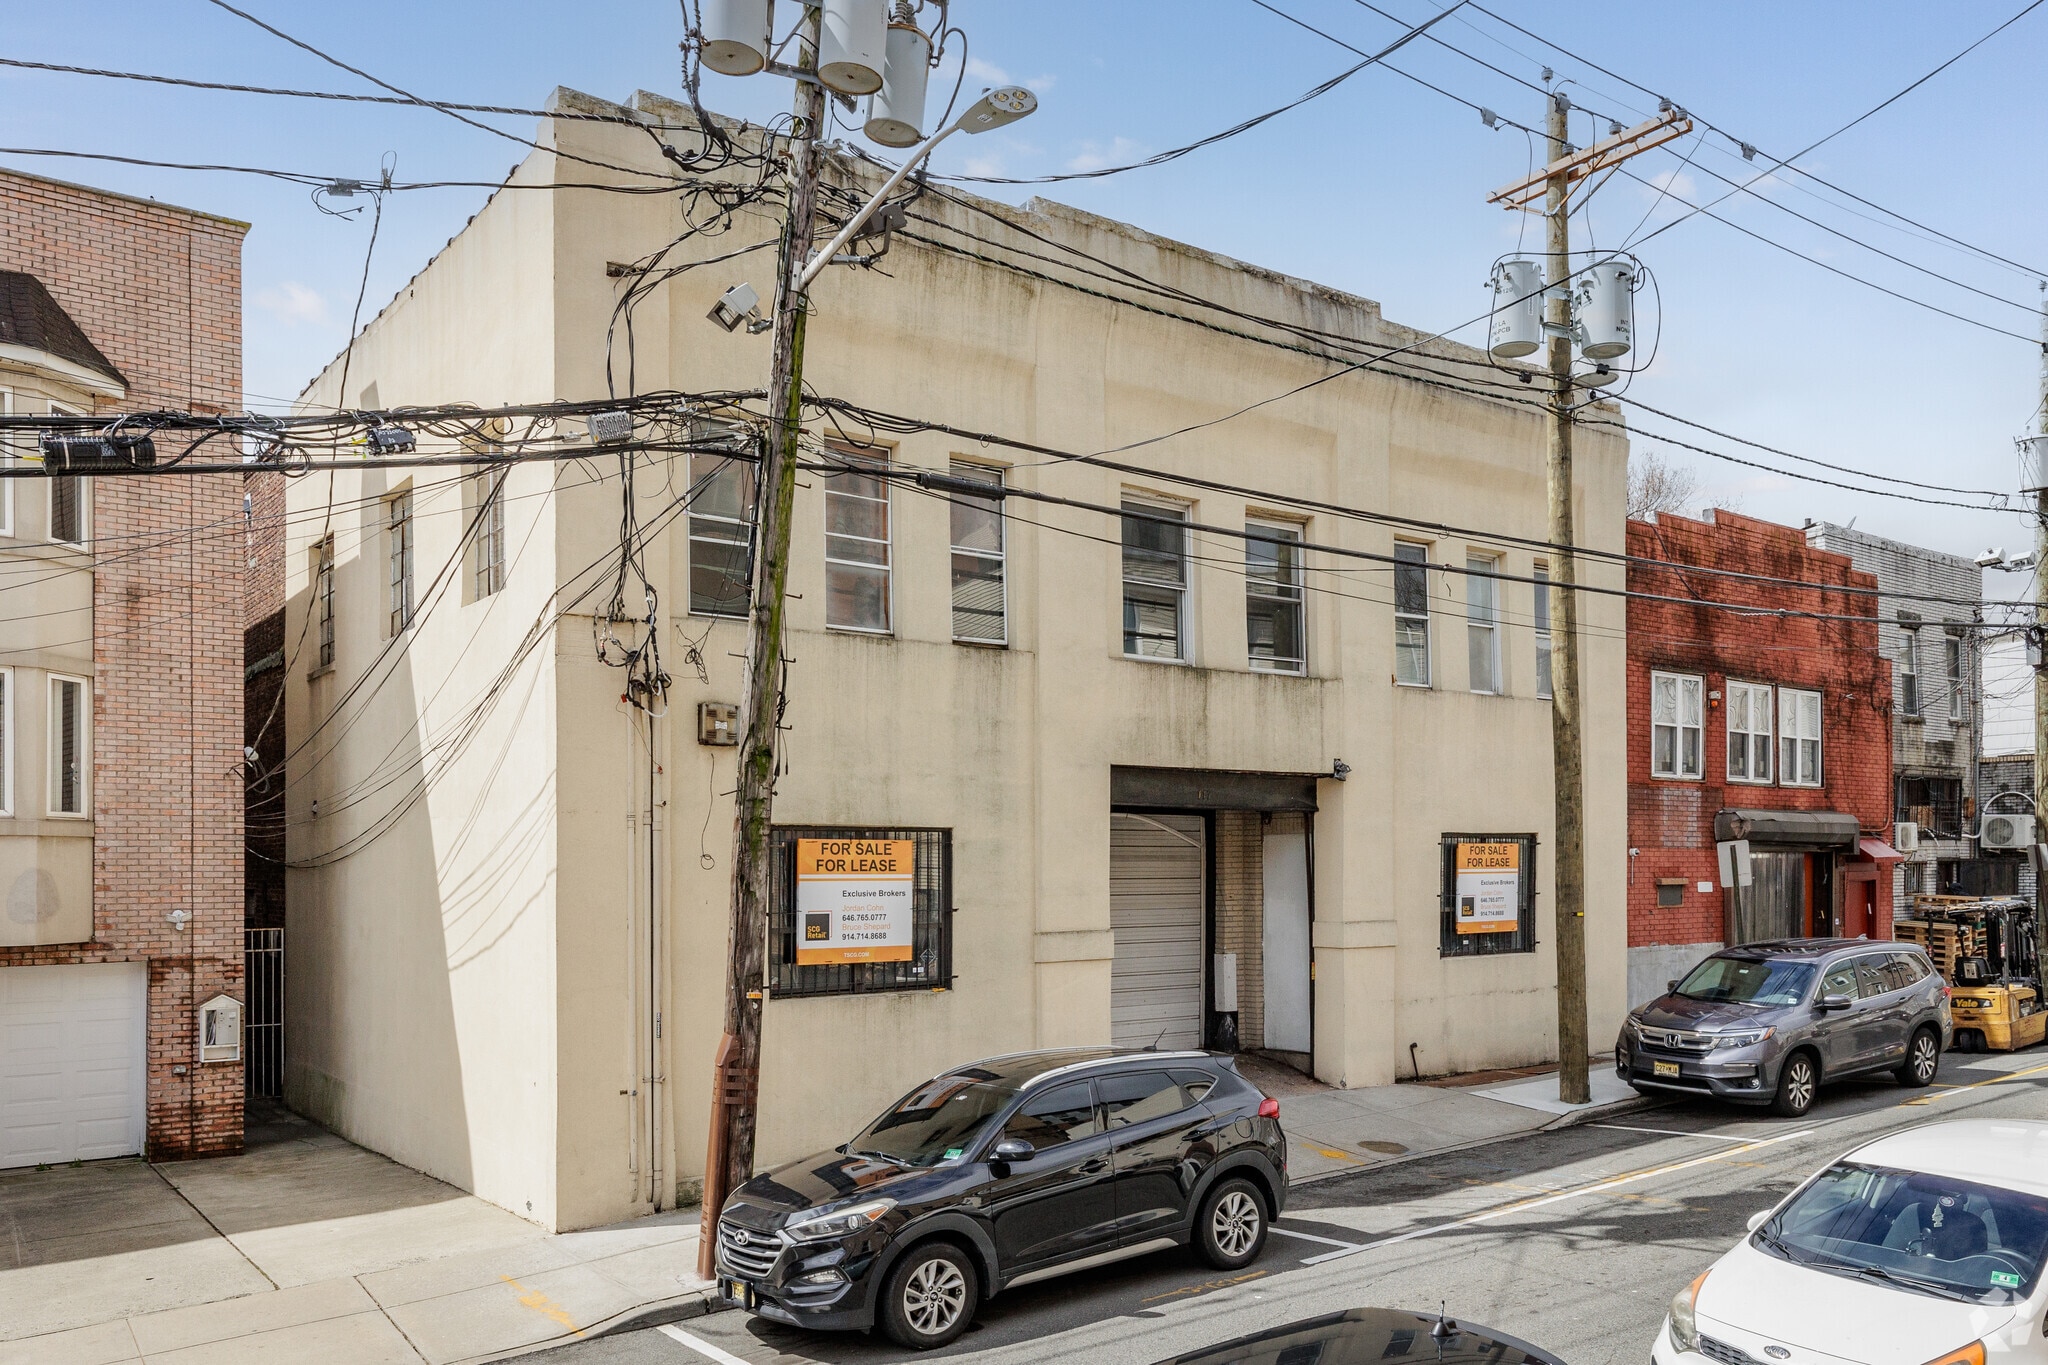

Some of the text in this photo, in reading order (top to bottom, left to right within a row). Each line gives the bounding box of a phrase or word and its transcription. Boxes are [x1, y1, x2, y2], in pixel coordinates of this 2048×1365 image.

[821, 842, 892, 855] FOR SALE
[1469, 845, 1508, 855] FOR SALE
[816, 859, 897, 872] FOR LEASE
[1467, 857, 1510, 867] FOR LEASE
[842, 889, 906, 898] Exclusive Brokers
[842, 904, 865, 912] Jordan
[842, 922, 891, 931] Bruce Shepard
[842, 932, 887, 940] 914.714.8688
[1955, 998, 1979, 1008] Yale
